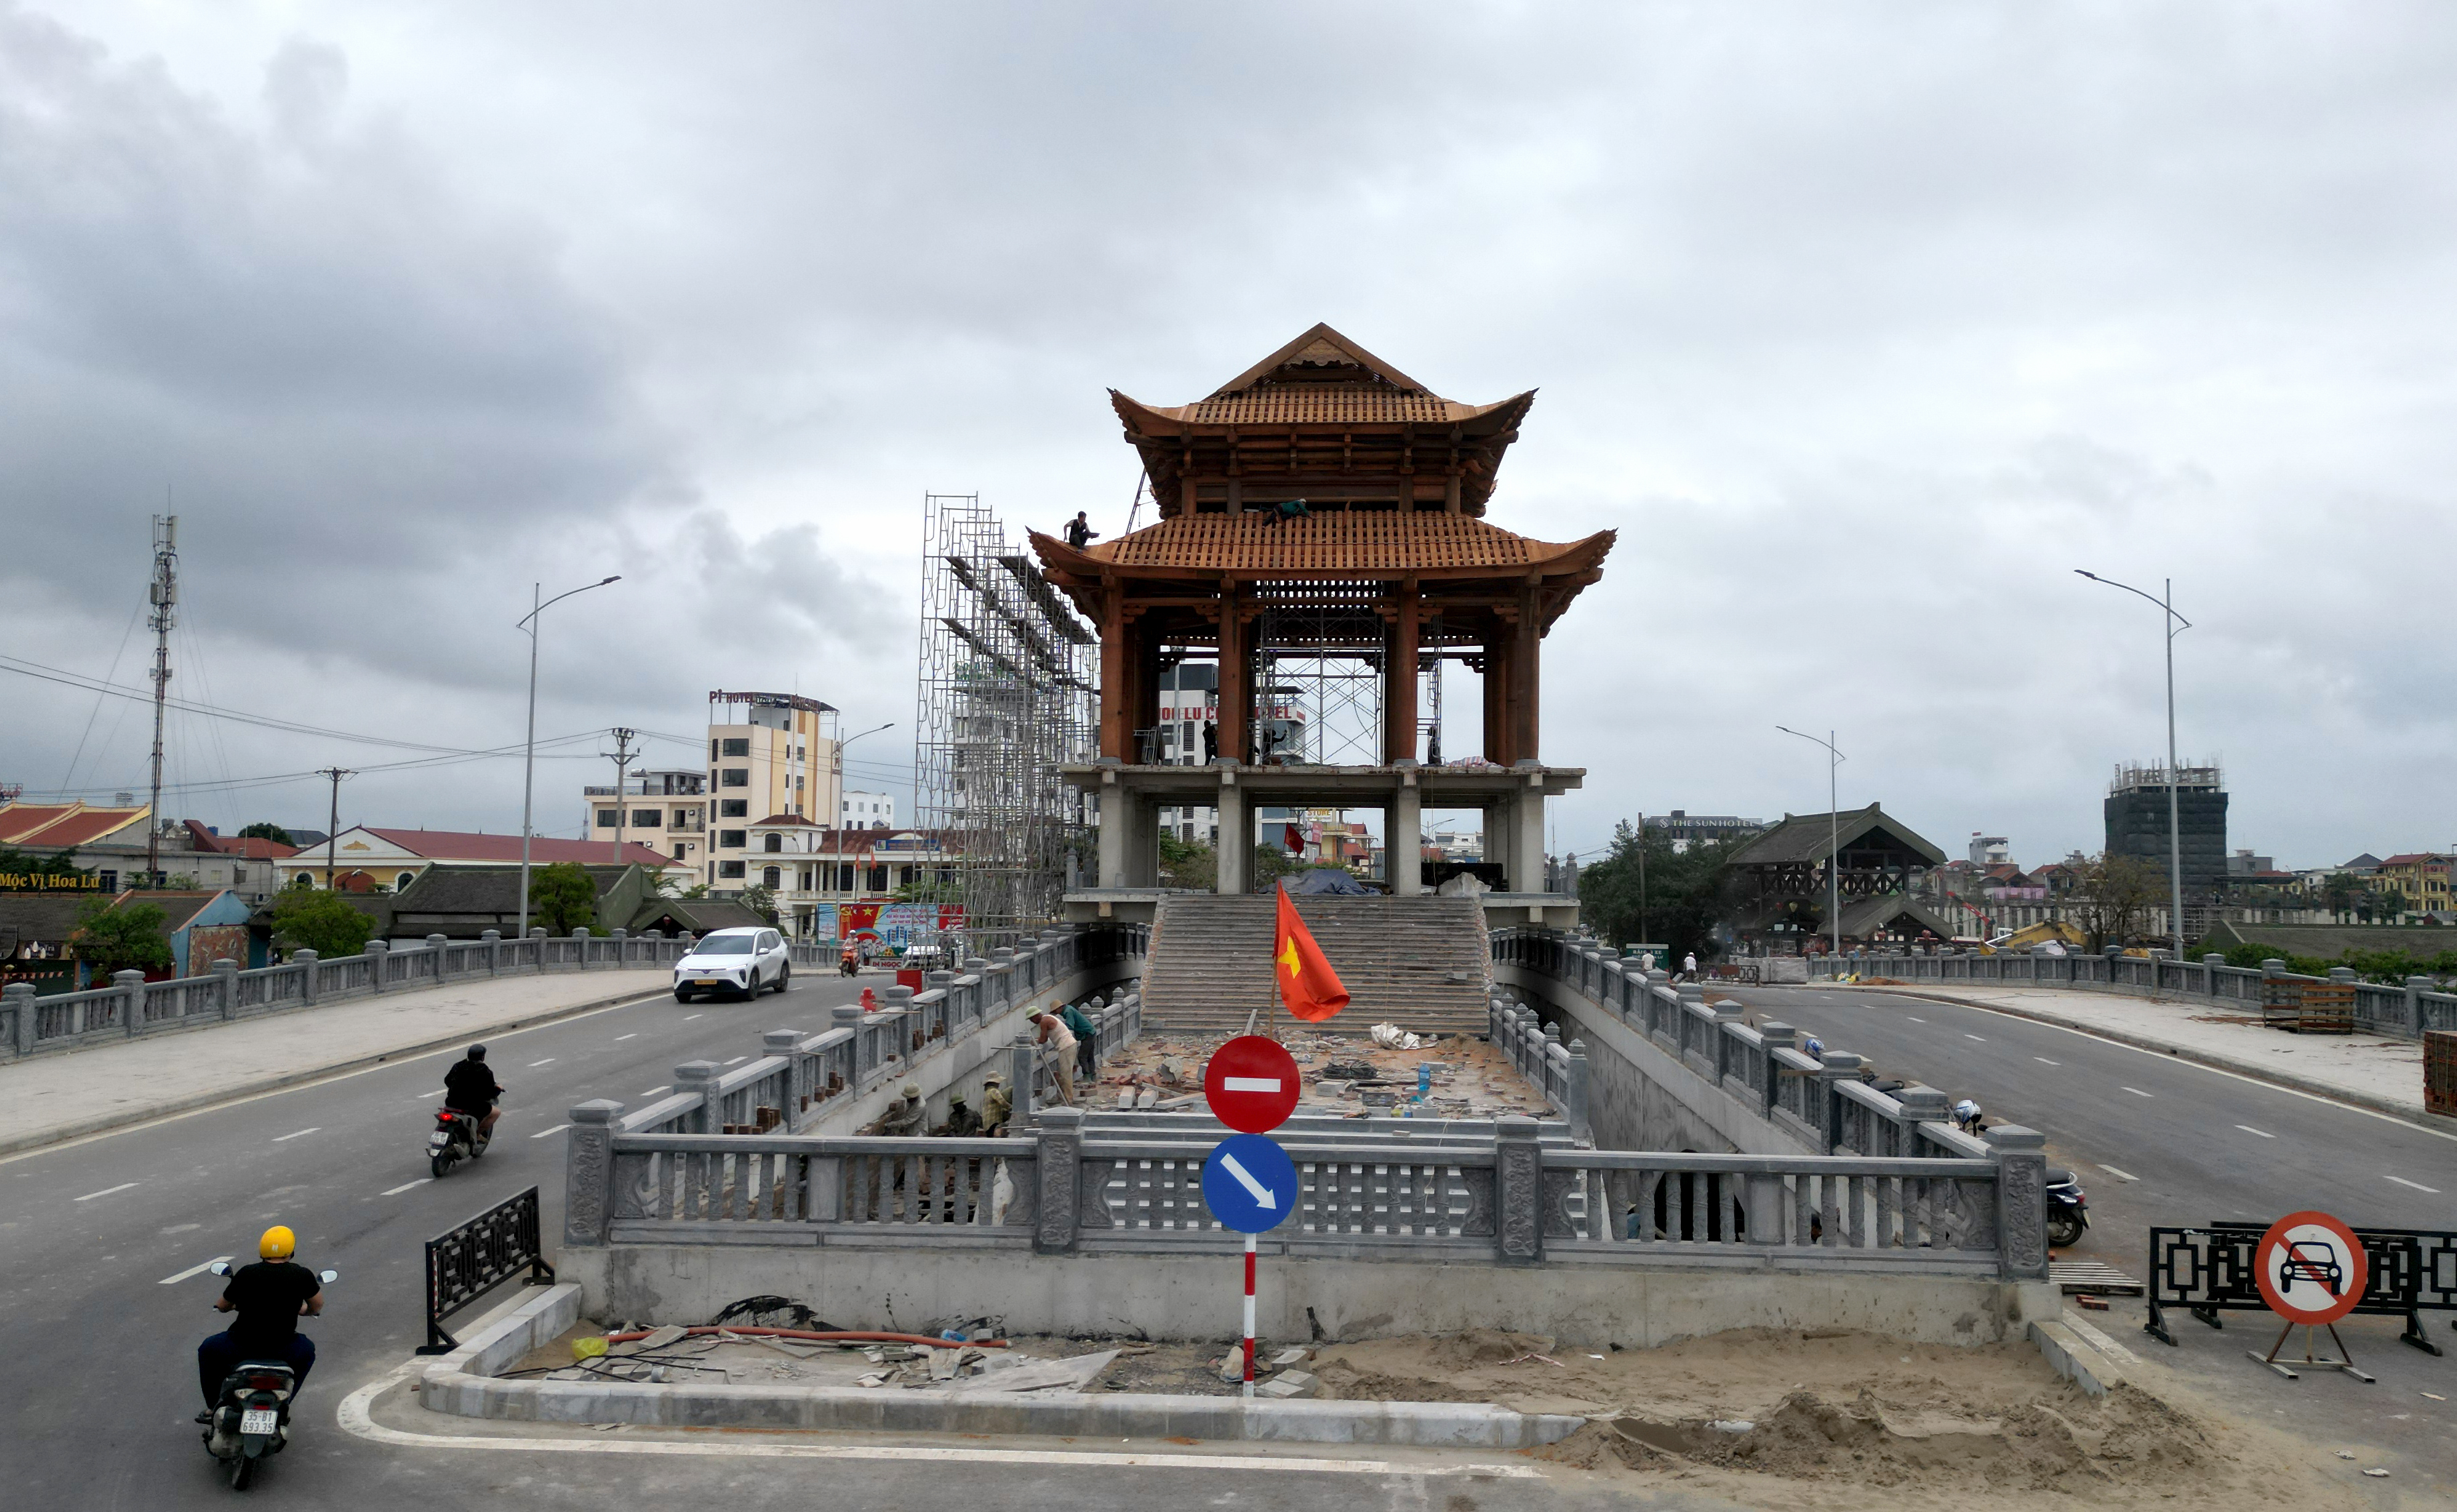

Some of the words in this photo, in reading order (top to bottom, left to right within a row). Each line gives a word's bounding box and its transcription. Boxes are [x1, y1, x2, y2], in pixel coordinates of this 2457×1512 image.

[1185, 707, 1201, 720] LU
[0, 873, 27, 891] Mộc
[29, 873, 45, 890] Vị
[49, 874, 77, 887] Hoa
[81, 875, 100, 888] Lư
[881, 961, 902, 969] NGỌC
[247, 1411, 272, 1422] 35-B1
[243, 1422, 273, 1433] 693.35
